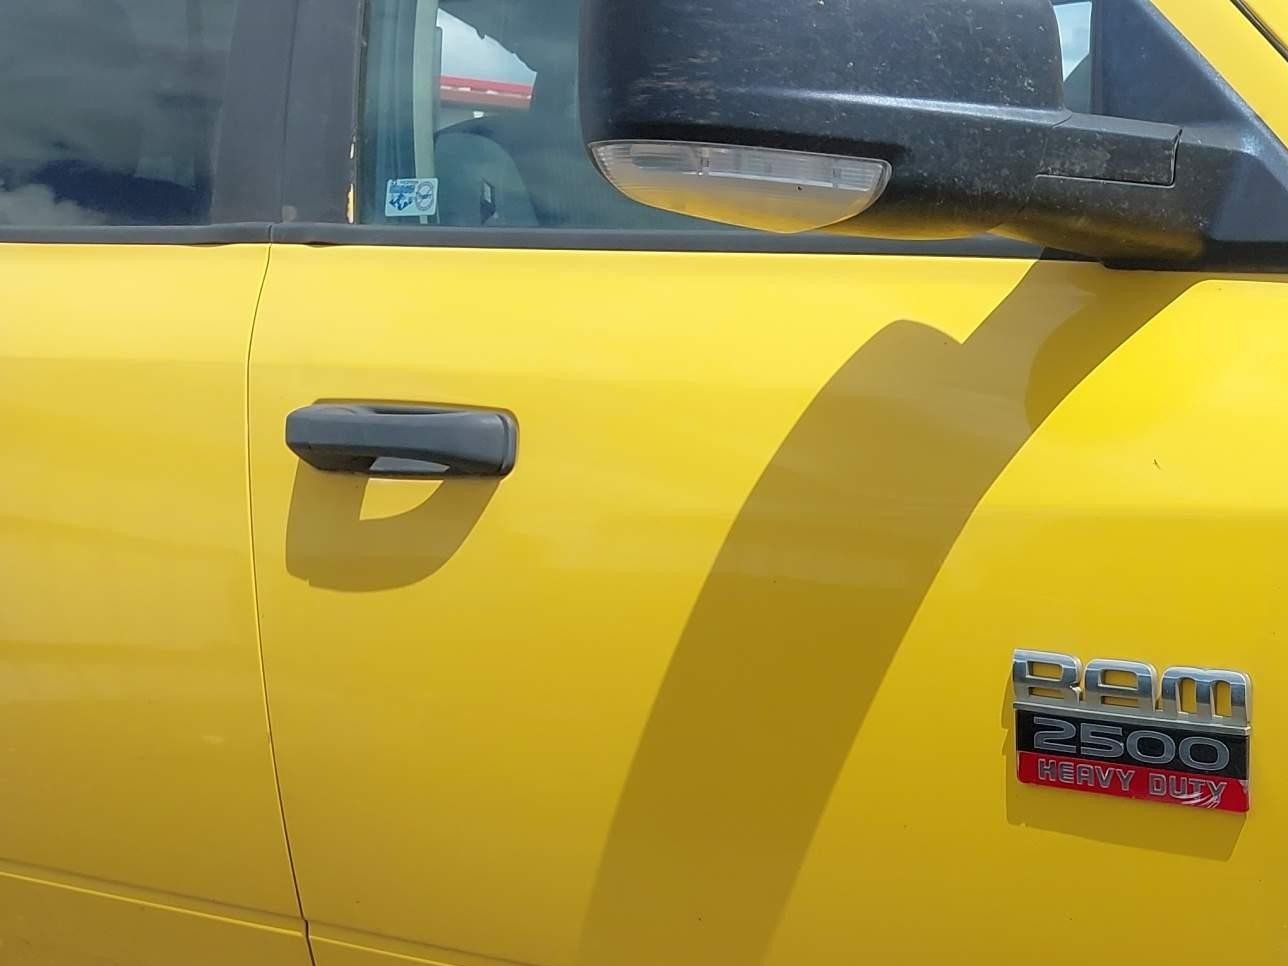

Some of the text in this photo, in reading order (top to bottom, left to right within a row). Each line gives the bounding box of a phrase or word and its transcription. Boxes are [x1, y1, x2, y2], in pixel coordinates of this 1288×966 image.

[1013, 648, 1252, 724] RAM
[1032, 716, 1231, 772] 2500
[1037, 758, 1228, 800] HEAVY DUTY
